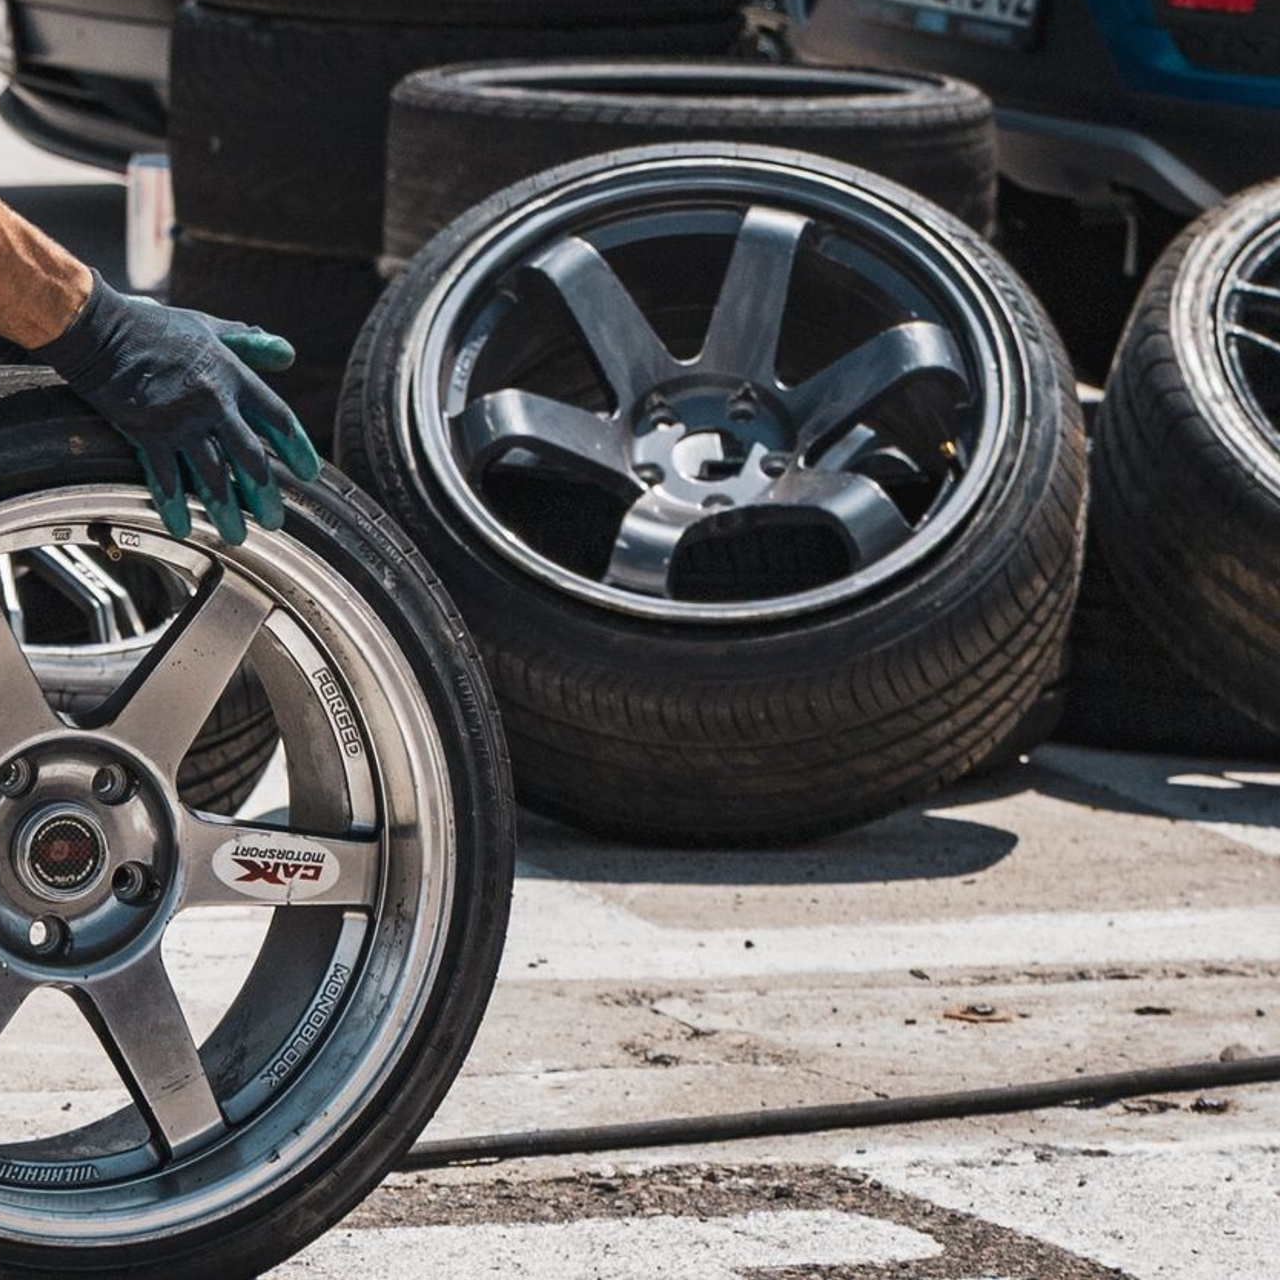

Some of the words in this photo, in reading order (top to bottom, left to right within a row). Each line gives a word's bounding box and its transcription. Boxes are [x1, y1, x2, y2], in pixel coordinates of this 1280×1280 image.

[314, 668, 362, 758] FORGED
[231, 846, 326, 864] MOTORSPORT
[261, 963, 351, 1087] MONOBLOCK
